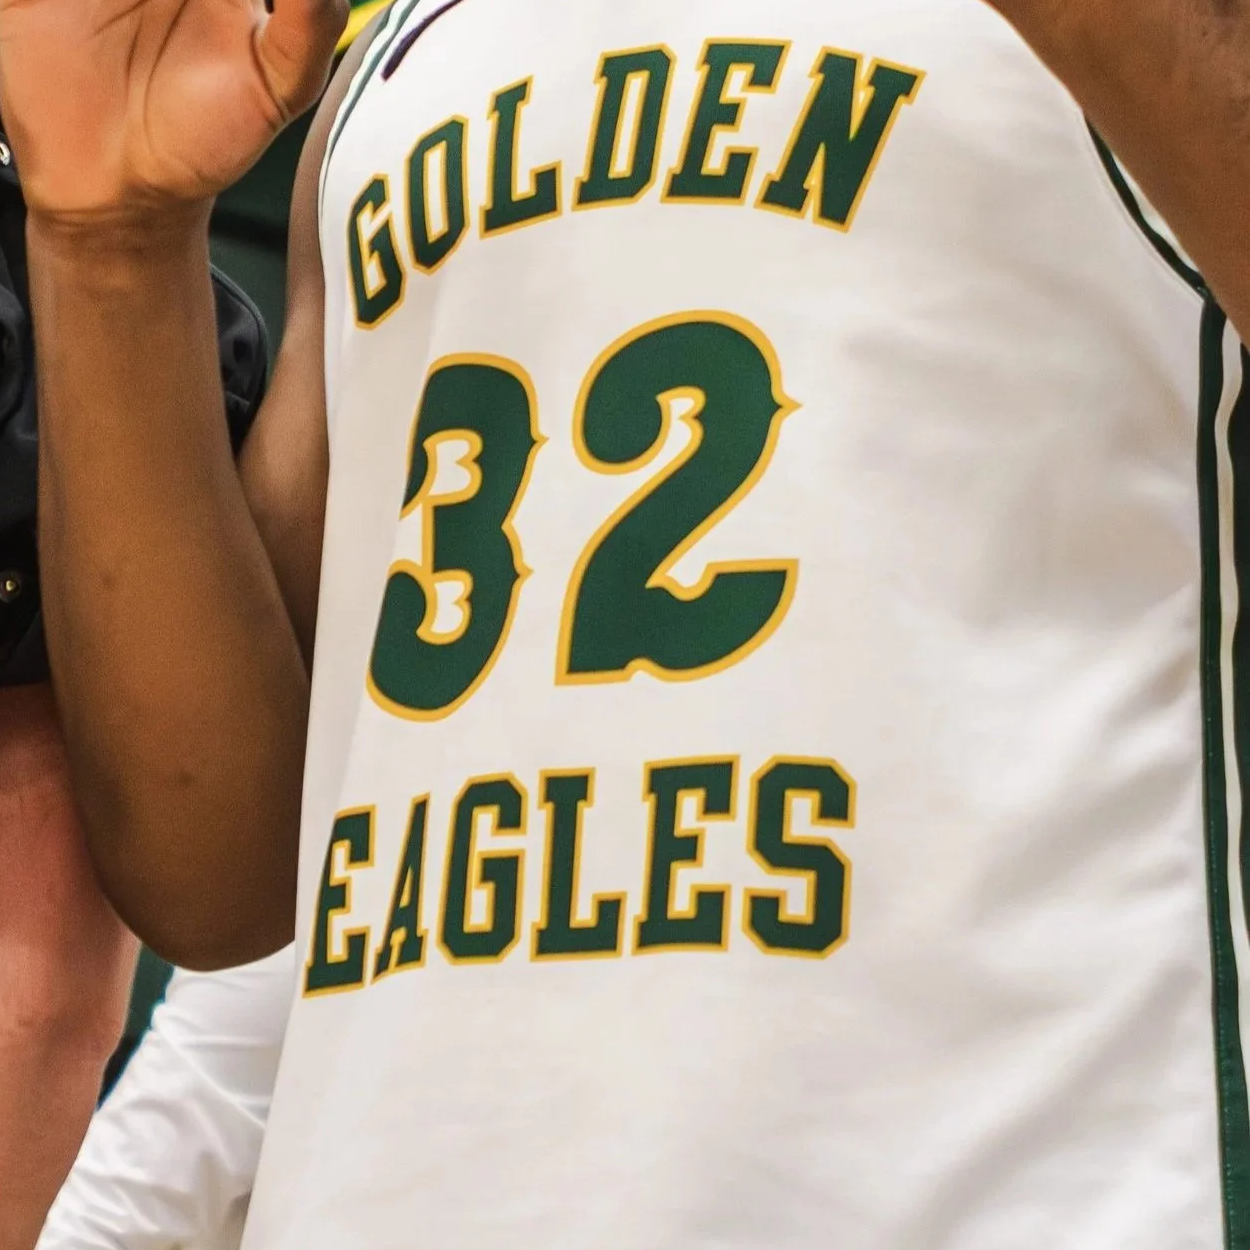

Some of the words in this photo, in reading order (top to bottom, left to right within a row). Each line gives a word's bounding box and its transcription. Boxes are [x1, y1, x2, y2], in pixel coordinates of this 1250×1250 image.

[346, 38, 927, 330] GOLDEN
[366, 309, 803, 722] 32
[301, 754, 857, 999] EAGLES
